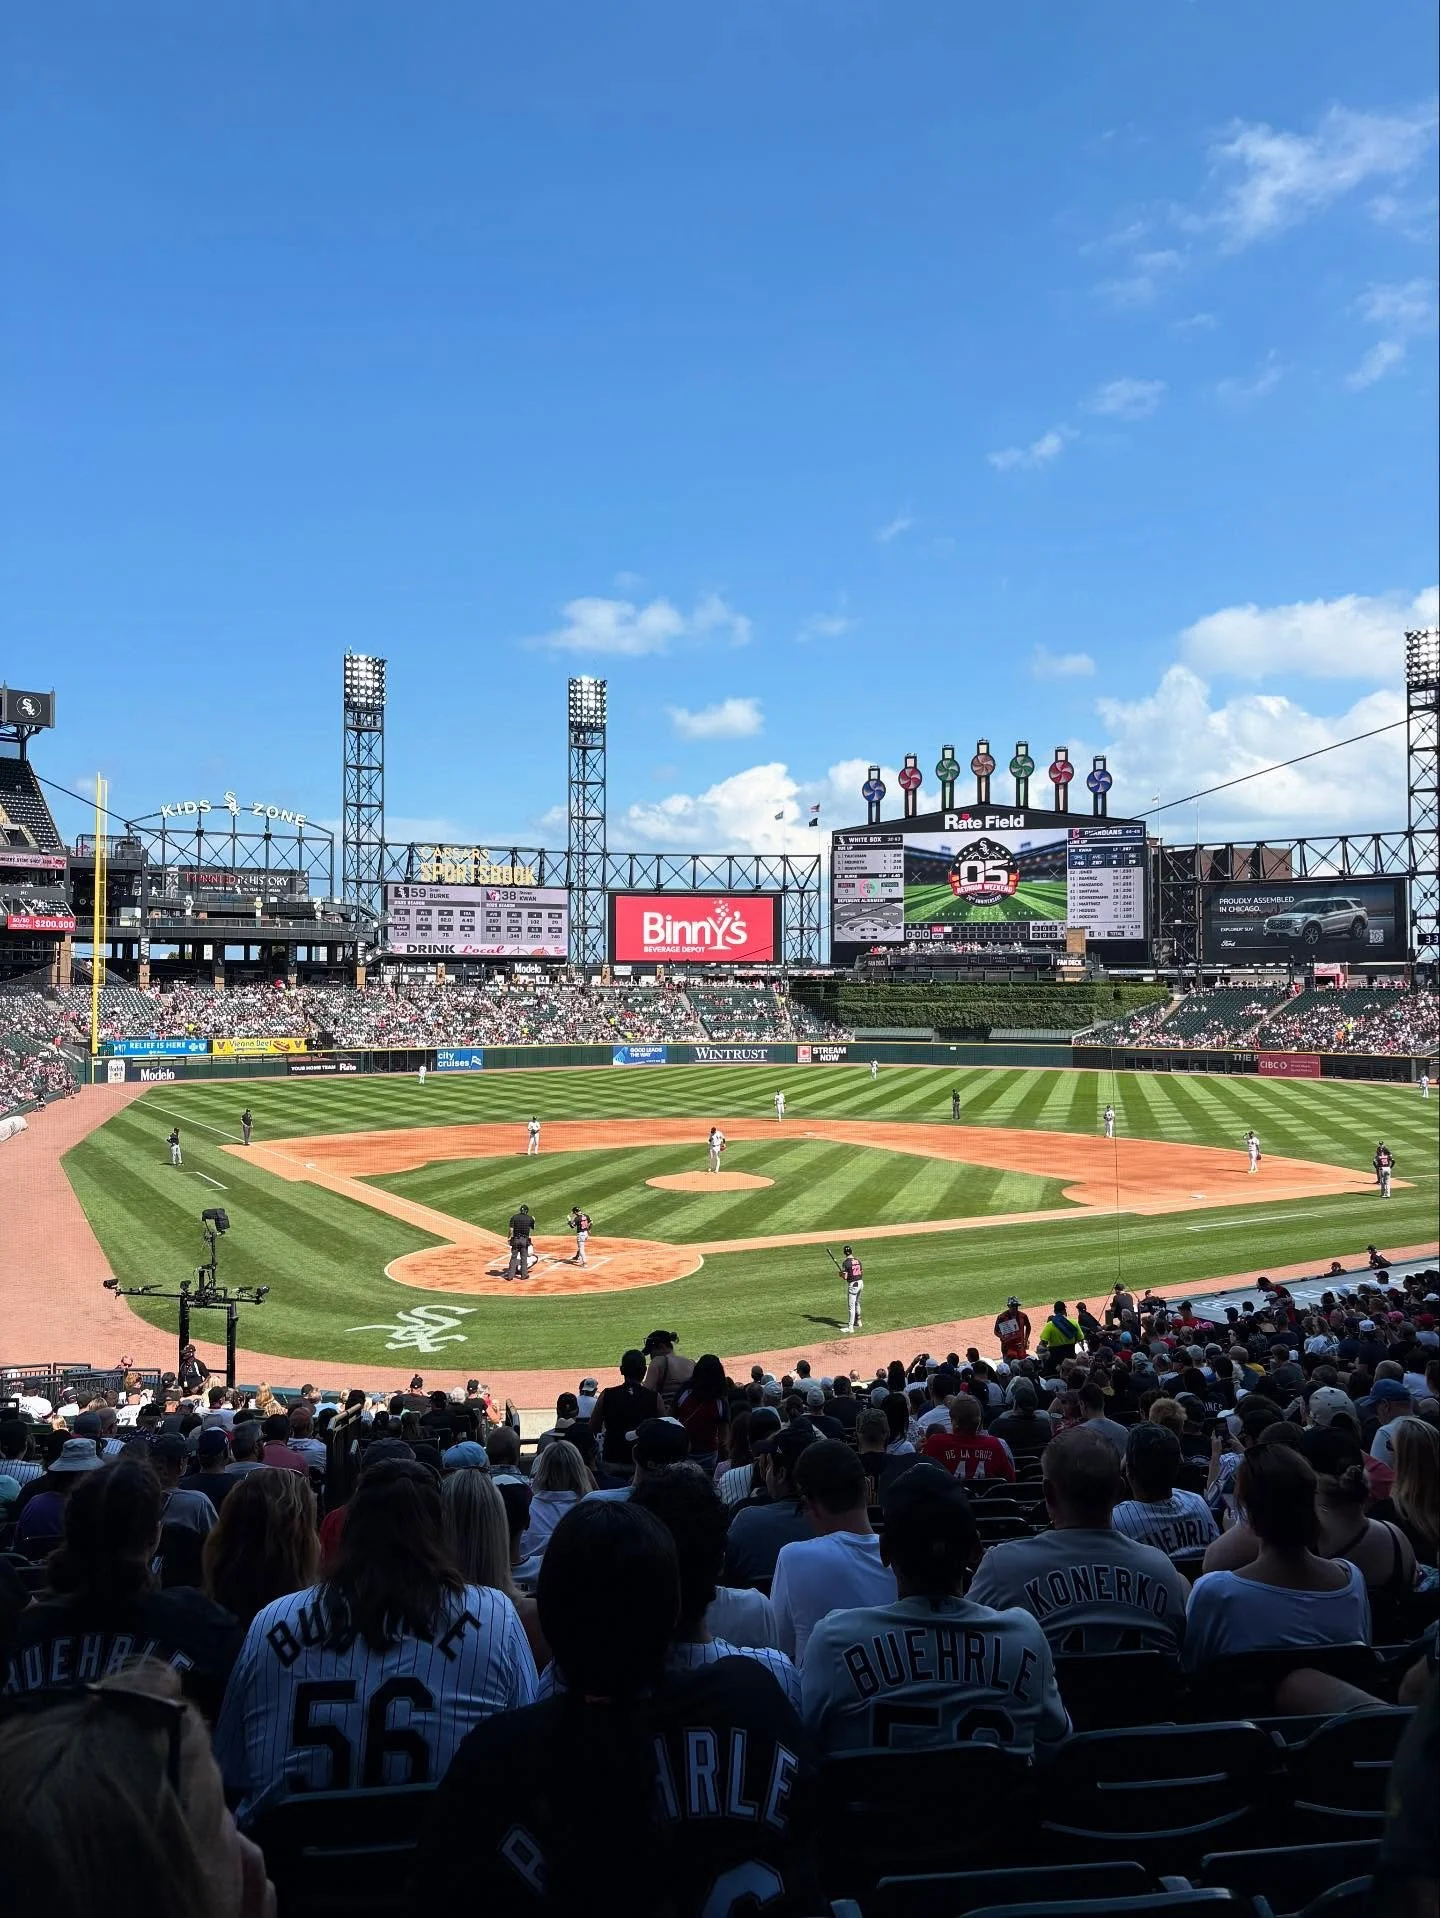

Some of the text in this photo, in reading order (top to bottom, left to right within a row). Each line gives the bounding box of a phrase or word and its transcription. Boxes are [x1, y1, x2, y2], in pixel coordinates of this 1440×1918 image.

[160, 799, 212, 818] KIDS
[252, 802, 307, 828] ZONE
[944, 814, 1025, 830] Rate Field
[420, 862, 538, 886] SPORTSBOOK
[960, 860, 1009, 886] 05
[411, 888, 427, 898] 59
[957, 883, 1013, 893] REUNION WEEKEND
[502, 891, 517, 901] 38
[1253, 896, 1294, 904] ASSEMBLED
[407, 944, 455, 953] DRINK
[460, 945, 505, 954] Local
[515, 963, 542, 974] Modelo
[129, 1041, 155, 1049] RELIEF
[165, 1041, 186, 1049] HERE
[812, 1046, 847, 1054] STREAM
[438, 1051, 455, 1061] city
[695, 1046, 768, 1059] WINTRUST
[820, 1054, 839, 1062] NOW
[438, 1059, 470, 1067] cruises
[1260, 1060, 1279, 1069] CIBC
[141, 1068, 175, 1081] Modelo
[960, 1448, 970, 1459] LA
[974, 1448, 993, 1460] CRUZ
[953, 1460, 986, 1480] 44
[1023, 1563, 1169, 1618] KONERKO
[842, 1627, 1038, 1702] BUEHRLE
[290, 1675, 435, 1790] 56
